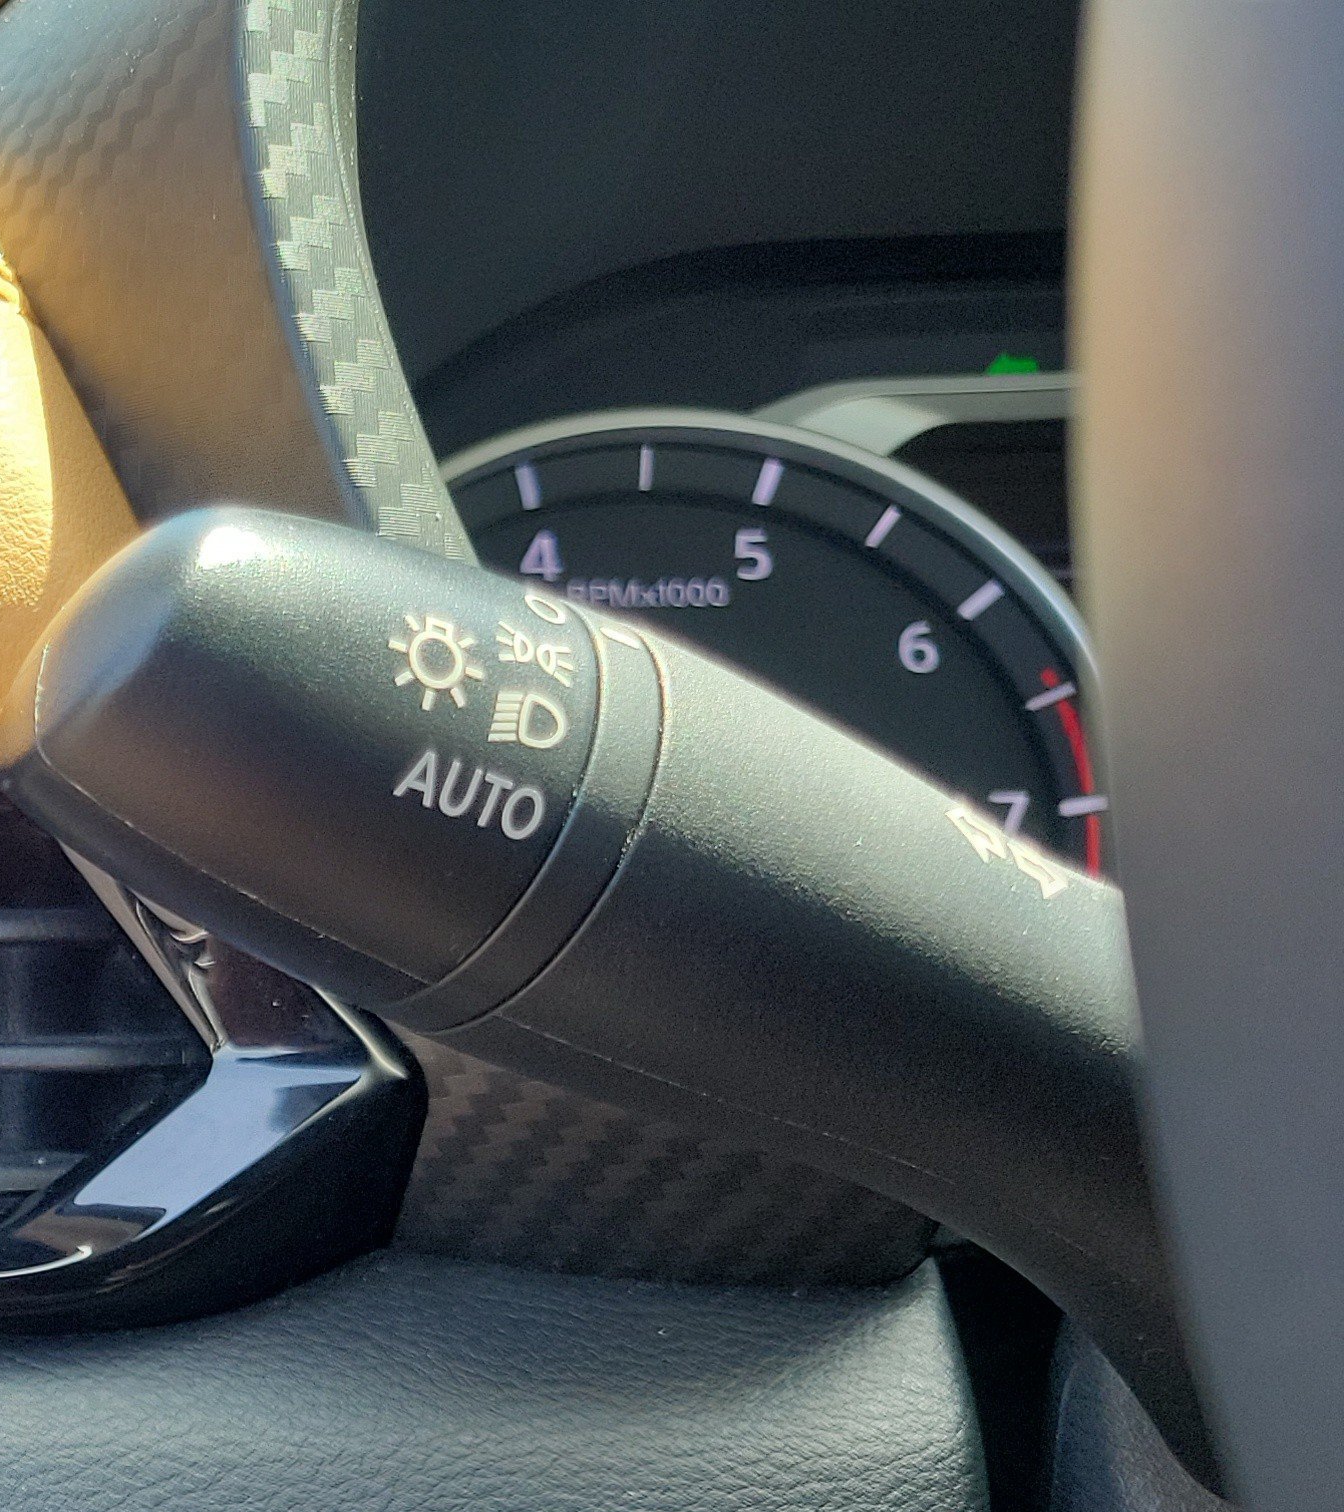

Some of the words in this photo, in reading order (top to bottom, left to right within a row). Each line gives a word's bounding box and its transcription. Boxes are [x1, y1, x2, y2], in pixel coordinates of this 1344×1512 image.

[519, 529, 562, 581] 4
[734, 528, 774, 581] 5
[898, 620, 940, 674] 6
[393, 750, 545, 840] AUTO
[988, 790, 1030, 834] 7
